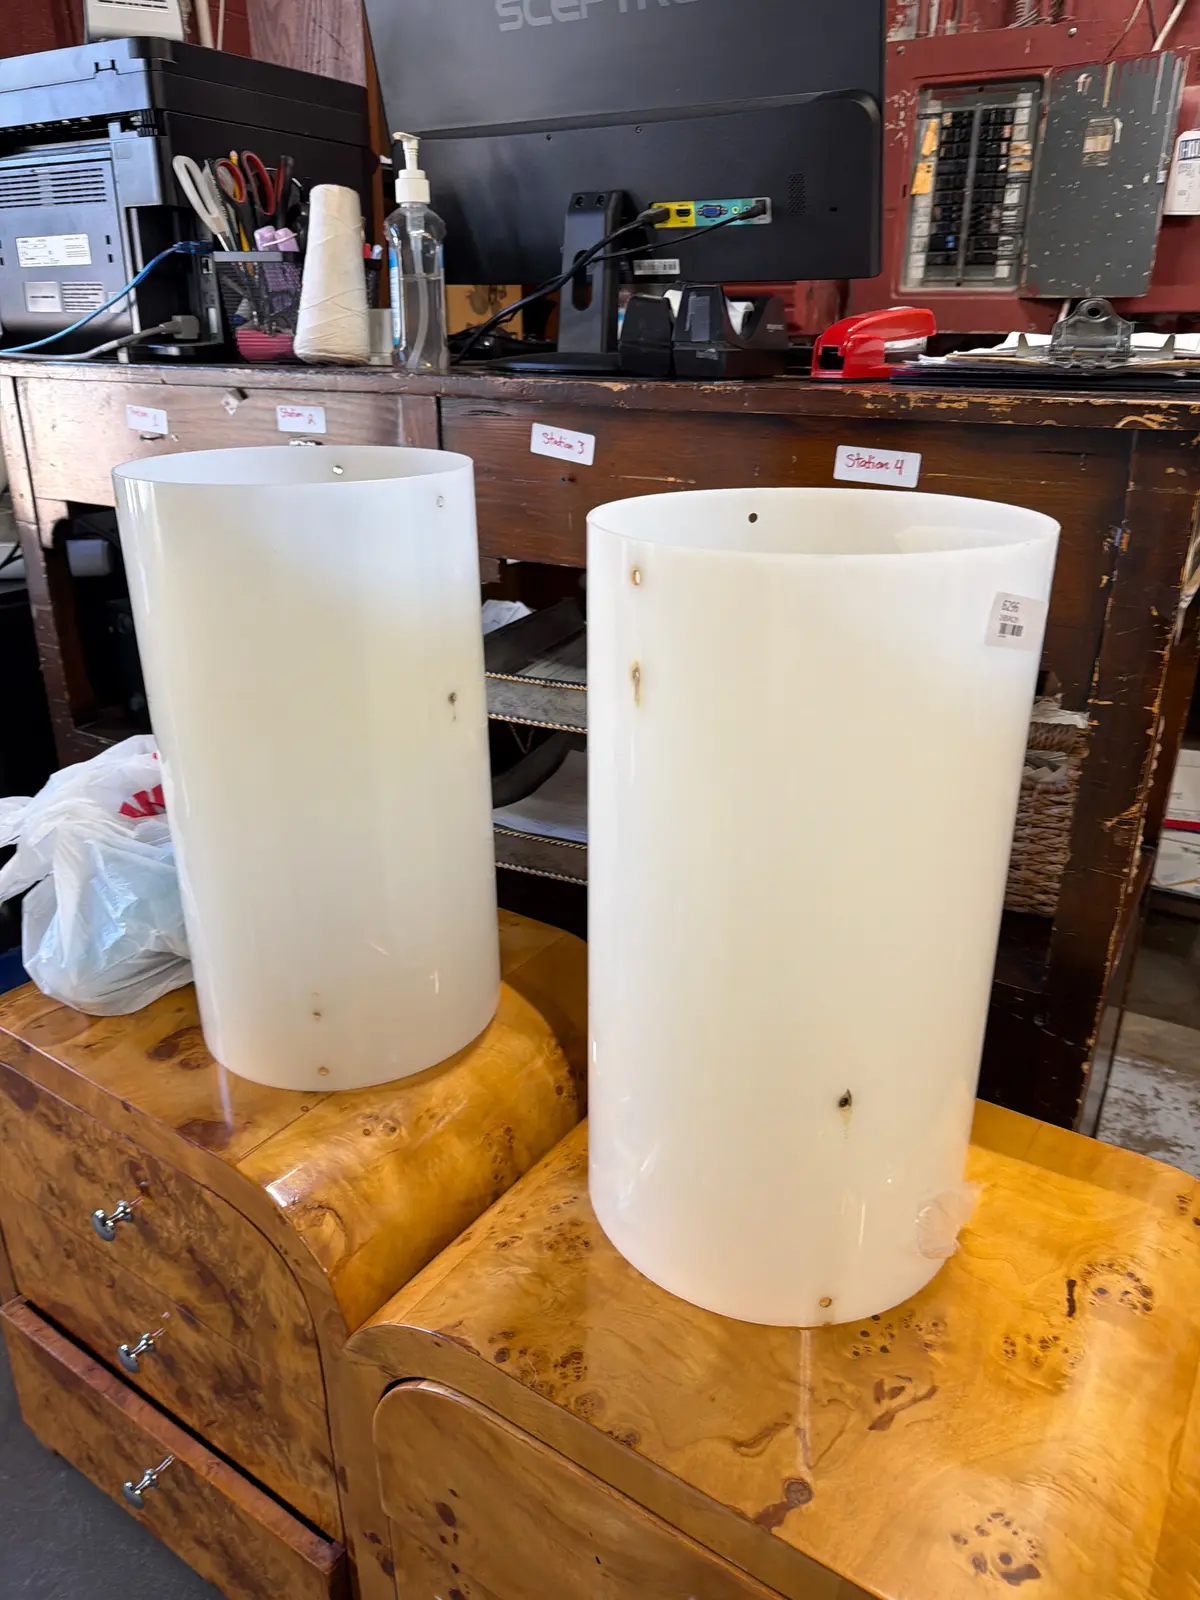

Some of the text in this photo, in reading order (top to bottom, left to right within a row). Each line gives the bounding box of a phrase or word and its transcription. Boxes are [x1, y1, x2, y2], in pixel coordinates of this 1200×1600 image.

[542, 431, 585, 455] Station 3
[845, 452, 905, 476] Station 4
